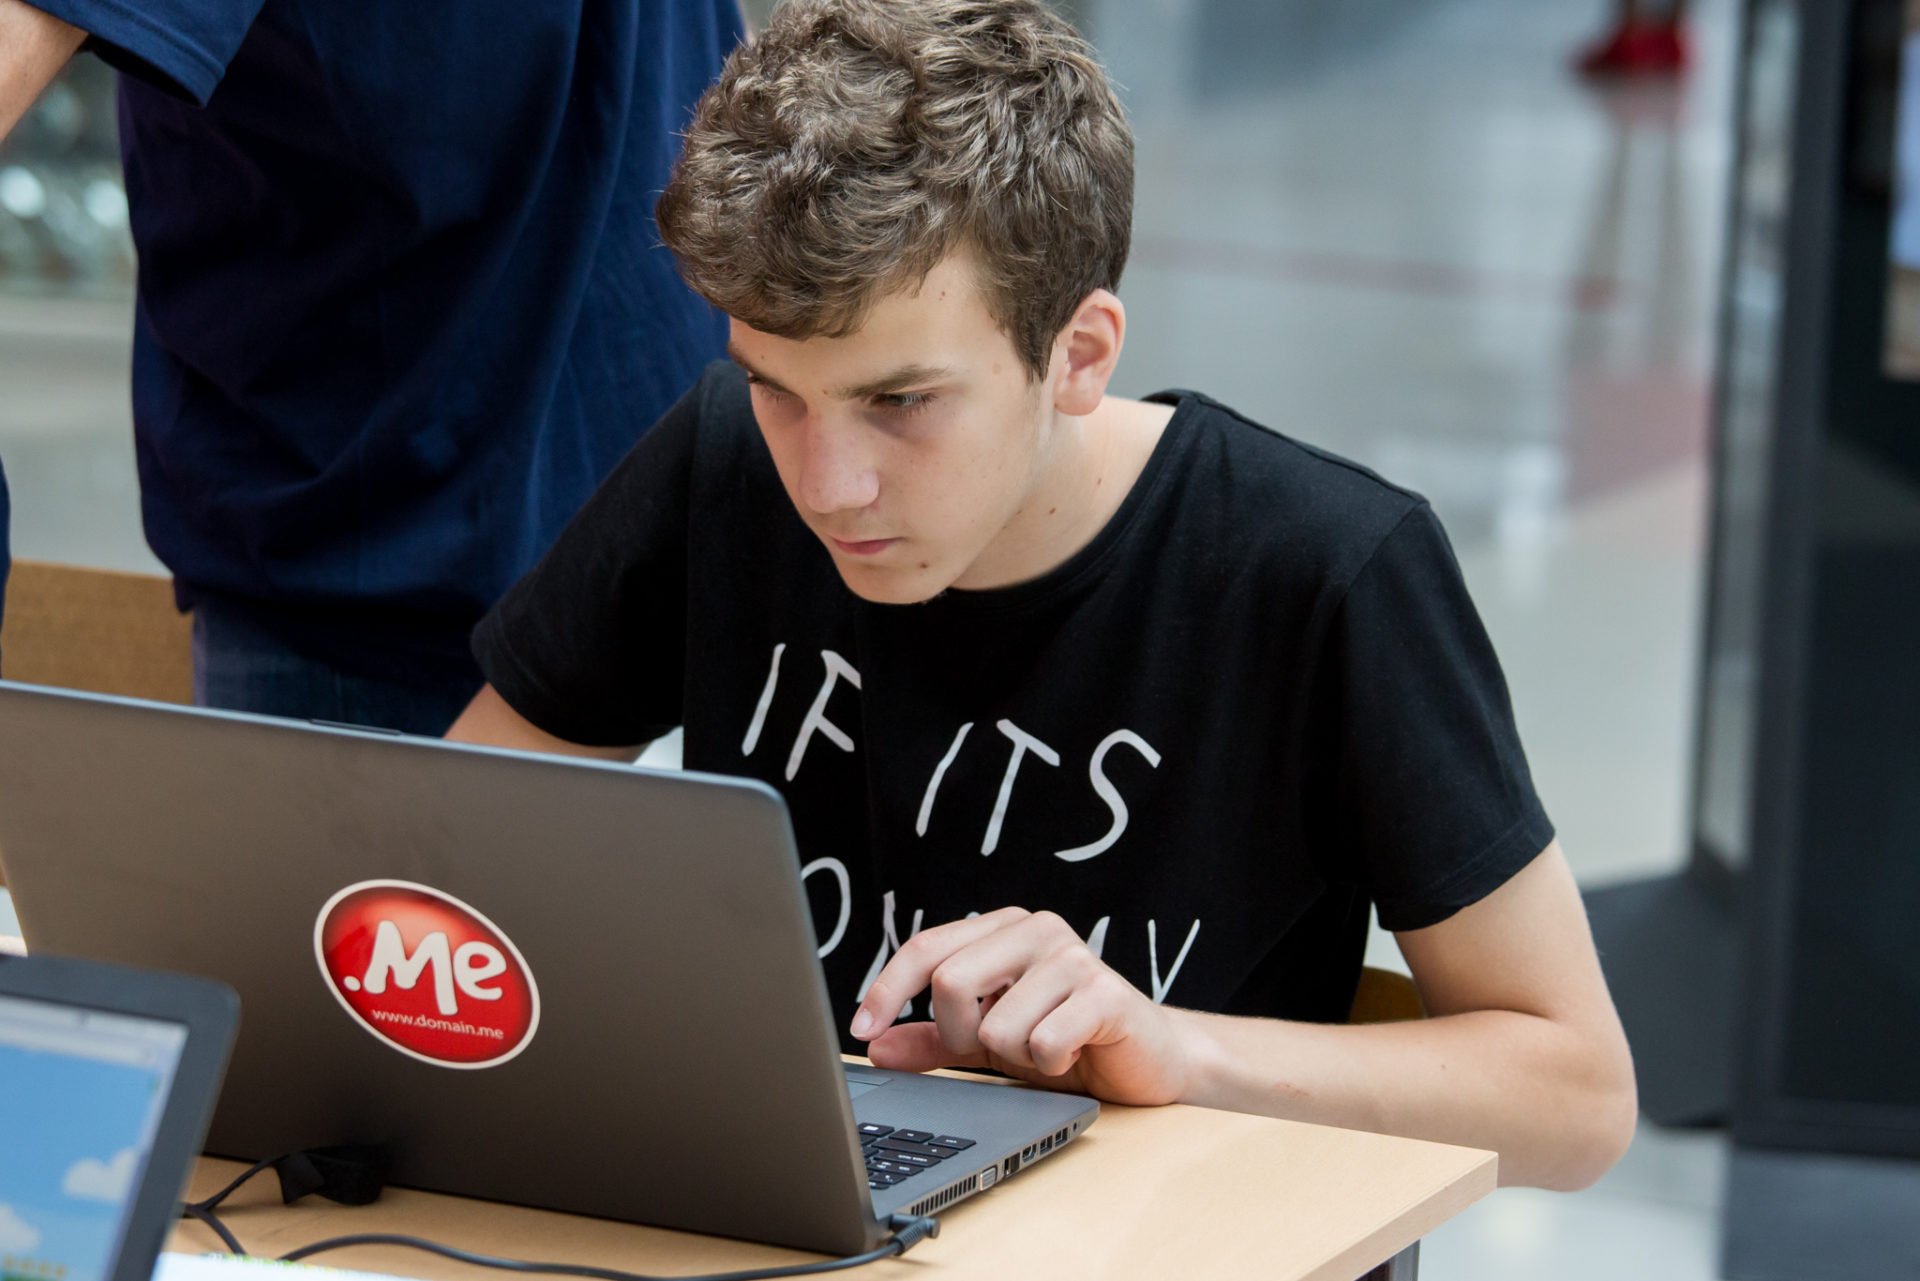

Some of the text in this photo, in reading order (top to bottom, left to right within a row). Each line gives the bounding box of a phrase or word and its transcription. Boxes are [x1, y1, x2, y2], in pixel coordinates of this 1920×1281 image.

[741, 643, 1161, 862] IF ITS
[371, 1009, 505, 1040] www.domain.me
